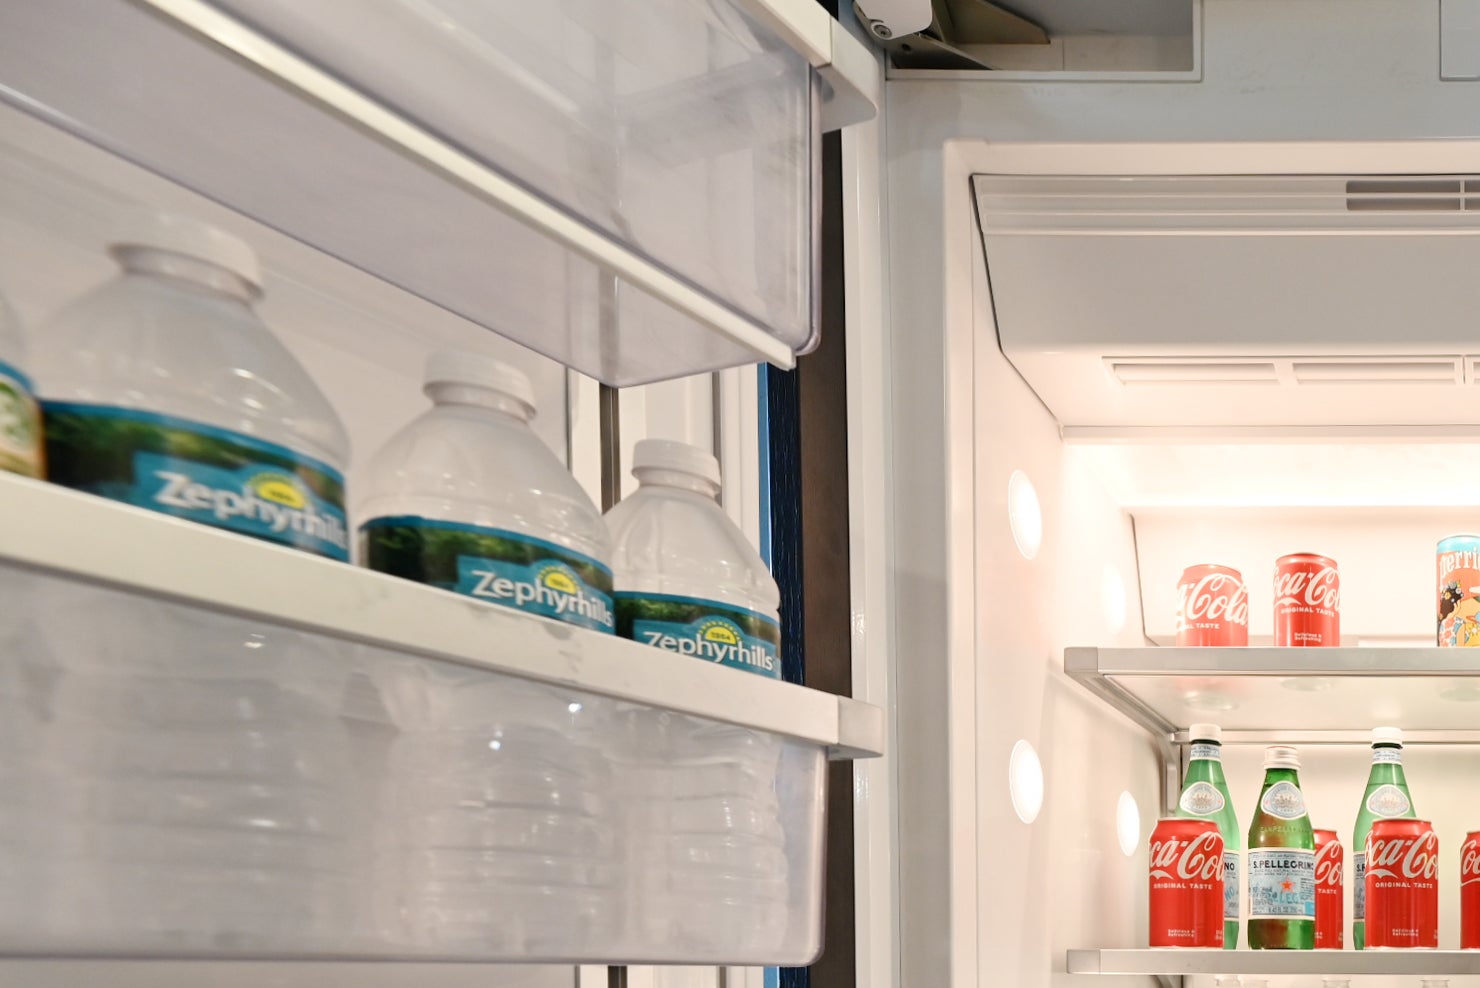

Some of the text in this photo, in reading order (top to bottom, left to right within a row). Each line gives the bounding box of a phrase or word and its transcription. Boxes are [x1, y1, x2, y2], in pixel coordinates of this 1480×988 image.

[471, 570, 613, 627] Zephyrhills
[643, 631, 773, 671] Zephyrhills
[1189, 882, 1213, 890] TASTE
